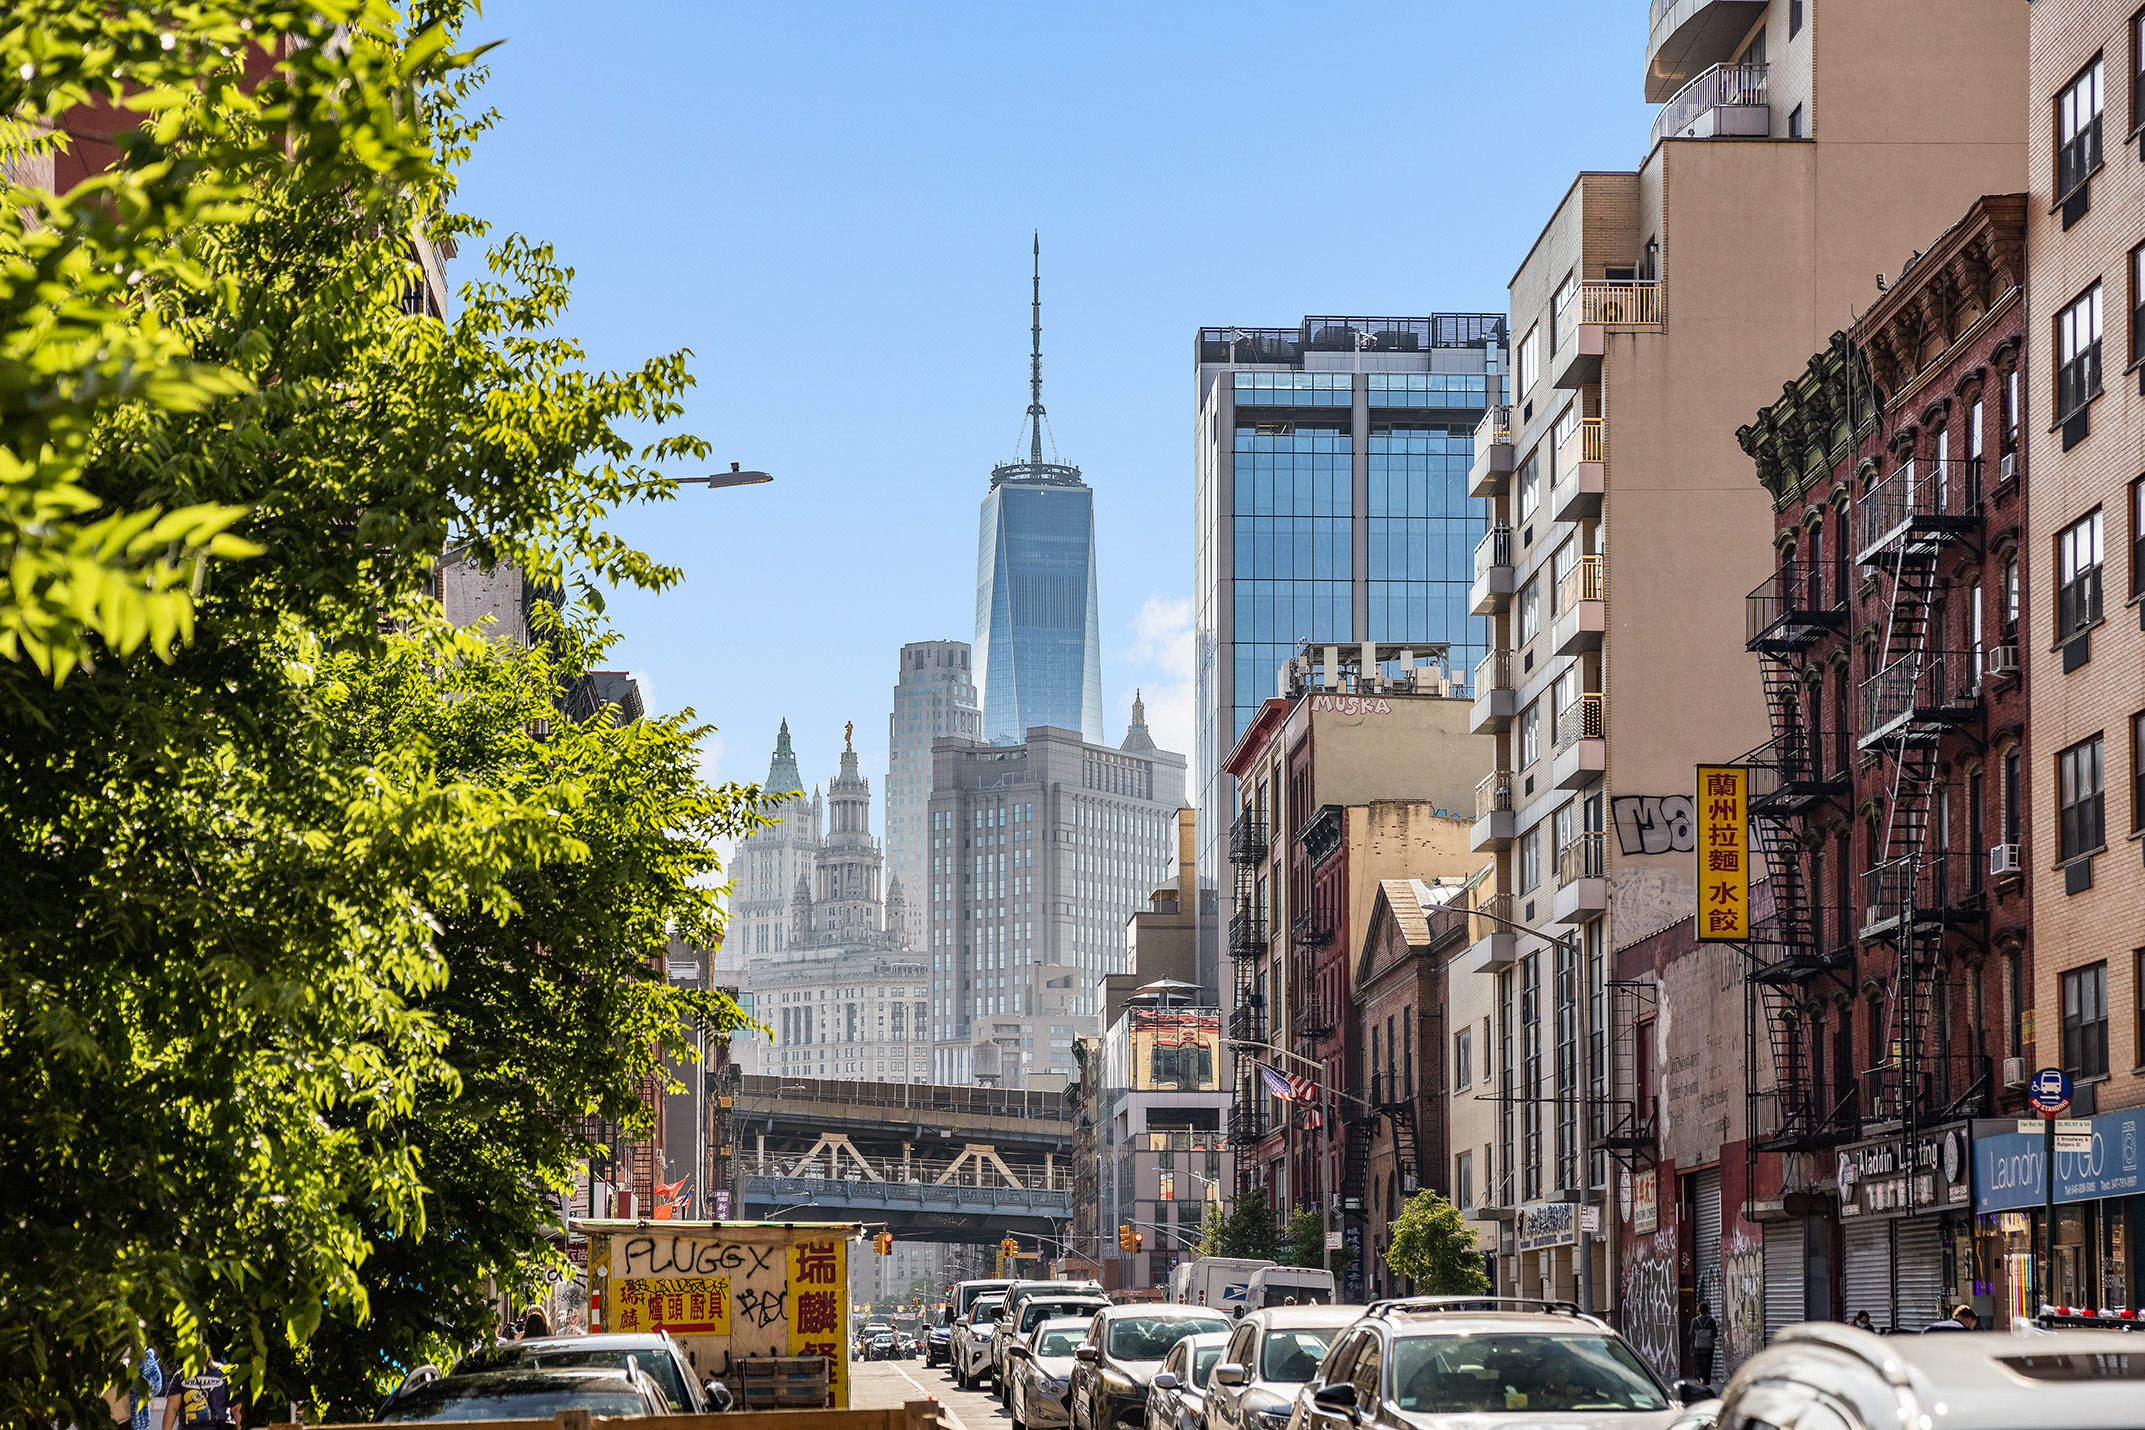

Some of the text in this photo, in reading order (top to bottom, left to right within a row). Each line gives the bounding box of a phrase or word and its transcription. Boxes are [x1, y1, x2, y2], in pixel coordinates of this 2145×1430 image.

[1311, 695, 1392, 716] MUSKA
[1707, 773, 1739, 932] 蘭州拉麵 水餃
[2040, 1099, 2069, 1112] STANDING
[1858, 1146, 1893, 1177] Aladdin
[1990, 1141, 2044, 1194] Laundry
[1071, 1260, 1090, 1268] 100
